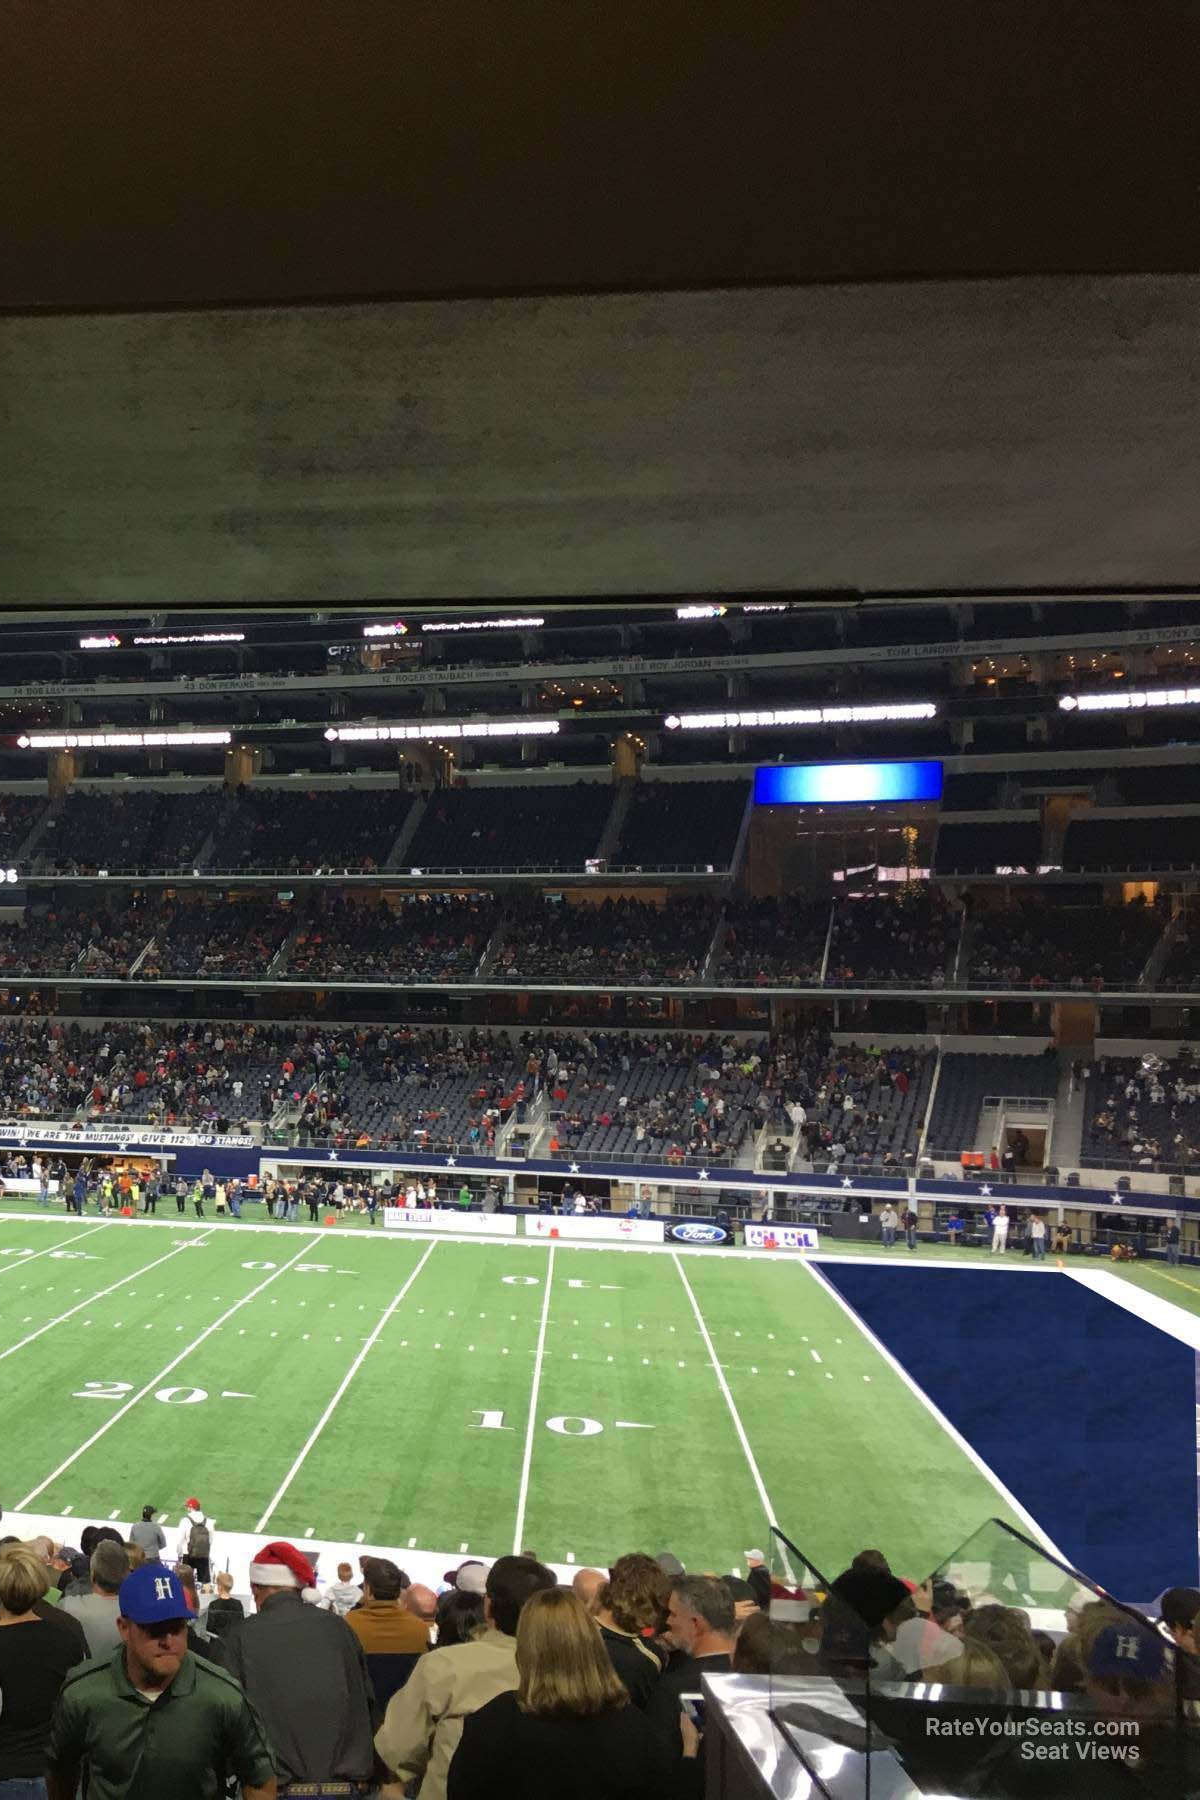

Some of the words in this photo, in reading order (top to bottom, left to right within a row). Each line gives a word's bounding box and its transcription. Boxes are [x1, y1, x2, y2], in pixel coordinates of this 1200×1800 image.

[26, 1129, 40, 1139] WE
[45, 1130, 60, 1140] ARE
[64, 1131, 81, 1141] THE
[85, 1131, 135, 1143] MUSTANGS!
[141, 1134, 167, 1143] GIVE
[682, 1229, 717, 1240] Ford
[71, 1380, 210, 1404] 20
[467, 1406, 605, 1427] 10
[153, 1576, 175, 1601] H
